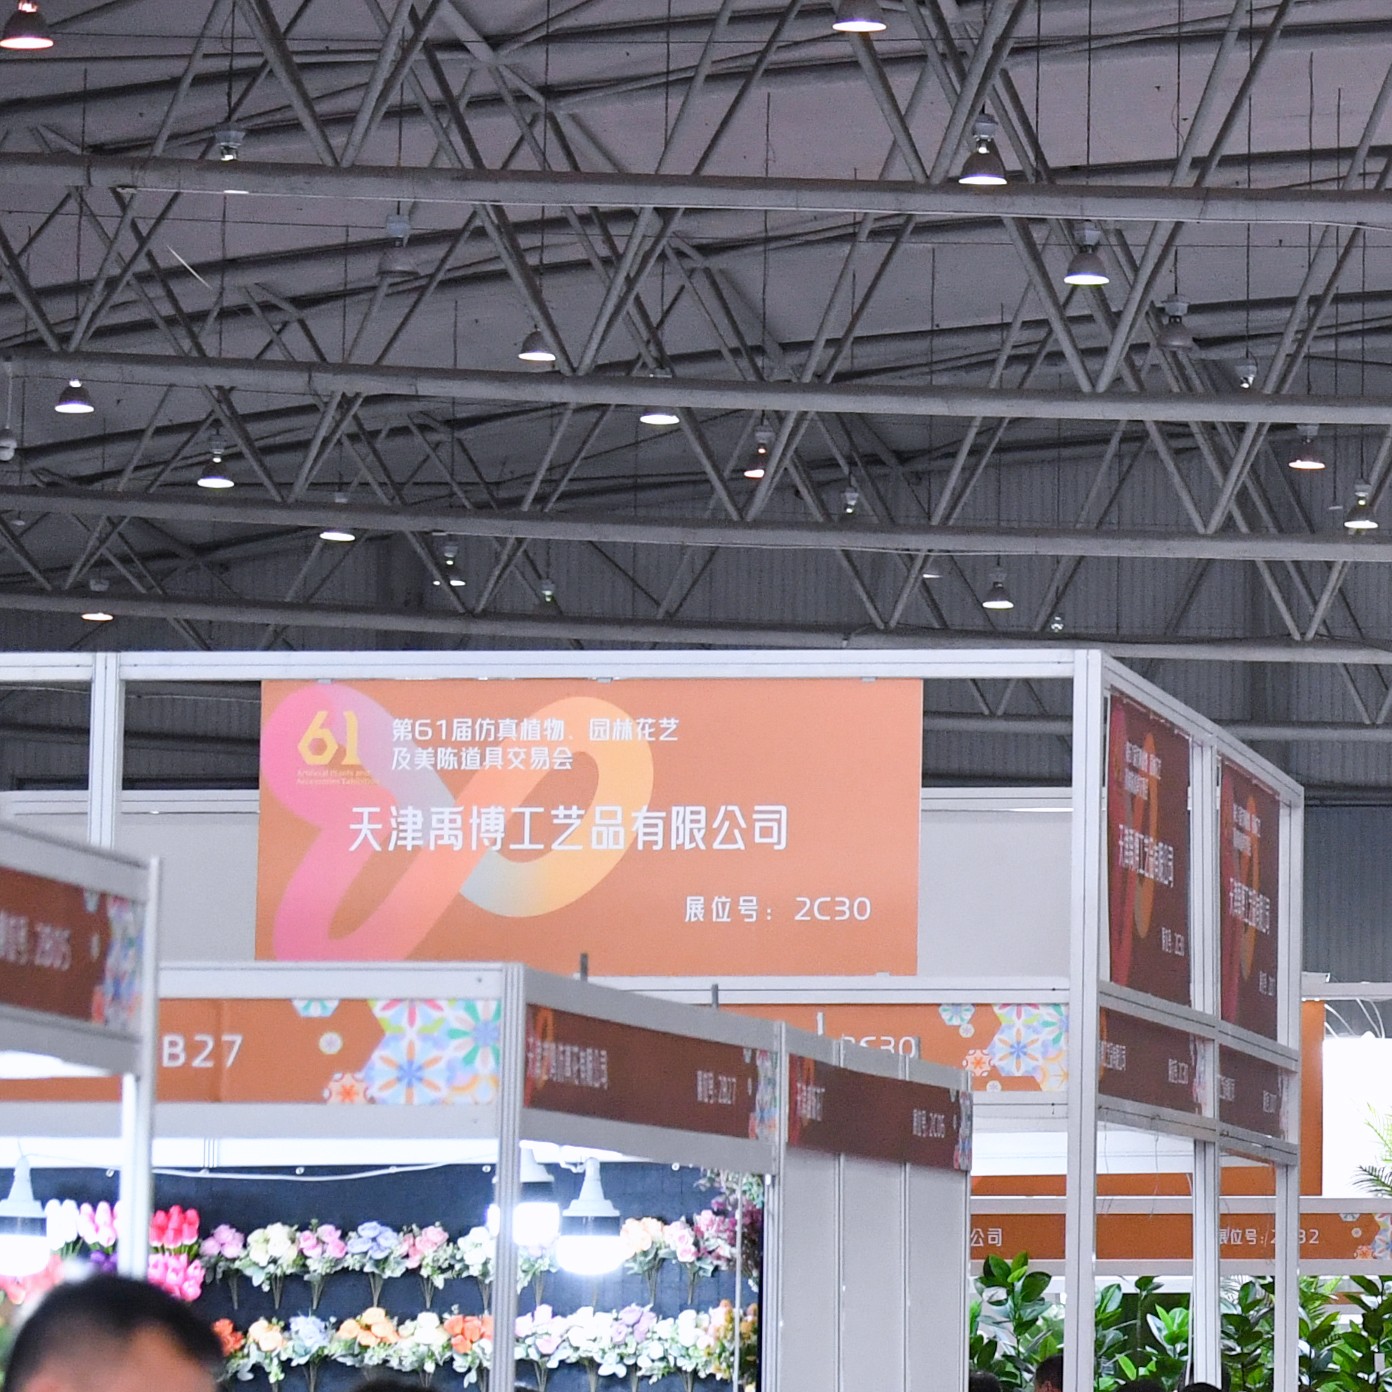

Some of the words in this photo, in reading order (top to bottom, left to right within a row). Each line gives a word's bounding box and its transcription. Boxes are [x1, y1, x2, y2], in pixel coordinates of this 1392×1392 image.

[298, 710, 361, 766] 61
[391, 717, 680, 742] 第61届仿真植物、园林花艺
[391, 746, 574, 771] 及美陈道具交易会
[348, 804, 789, 853] 天津禹博工艺品有限公司
[794, 897, 872, 922] 2C30
[970, 1227, 1003, 1247] 公司
